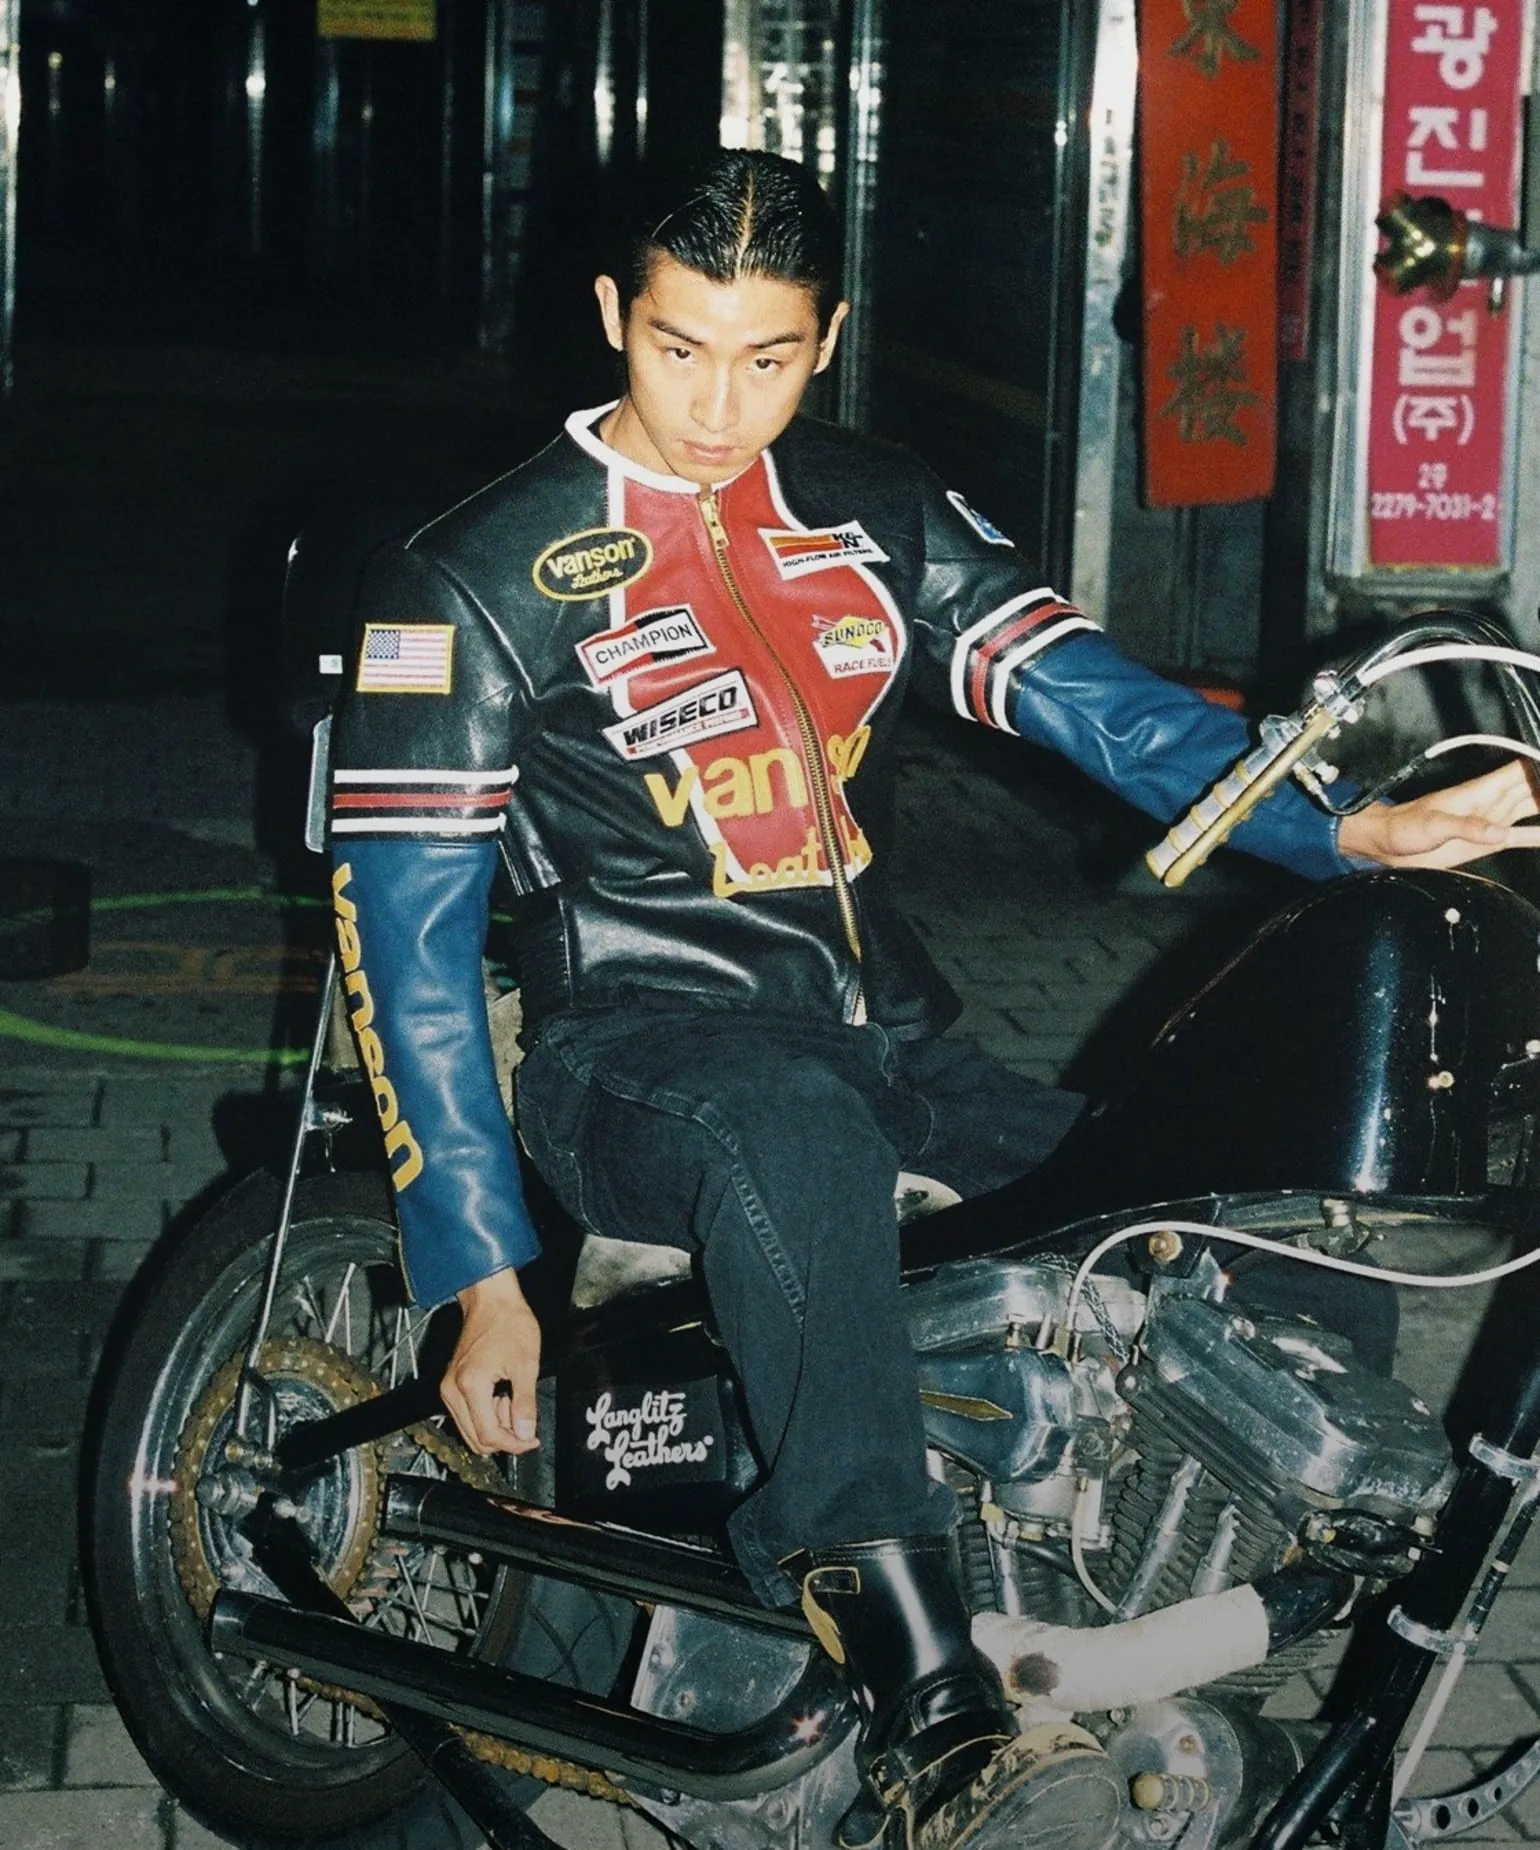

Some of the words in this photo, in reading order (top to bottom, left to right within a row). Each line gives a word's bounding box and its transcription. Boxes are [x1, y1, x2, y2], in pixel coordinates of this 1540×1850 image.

[546, 537, 636, 579] vanson
[594, 623, 693, 665] CHAMPION
[822, 621, 883, 649] SUNOCO
[834, 660, 865, 674] RACE
[622, 686, 738, 746] WISECO
[585, 1390, 688, 1450] Langlitz
[604, 1423, 709, 1491] Leathers
